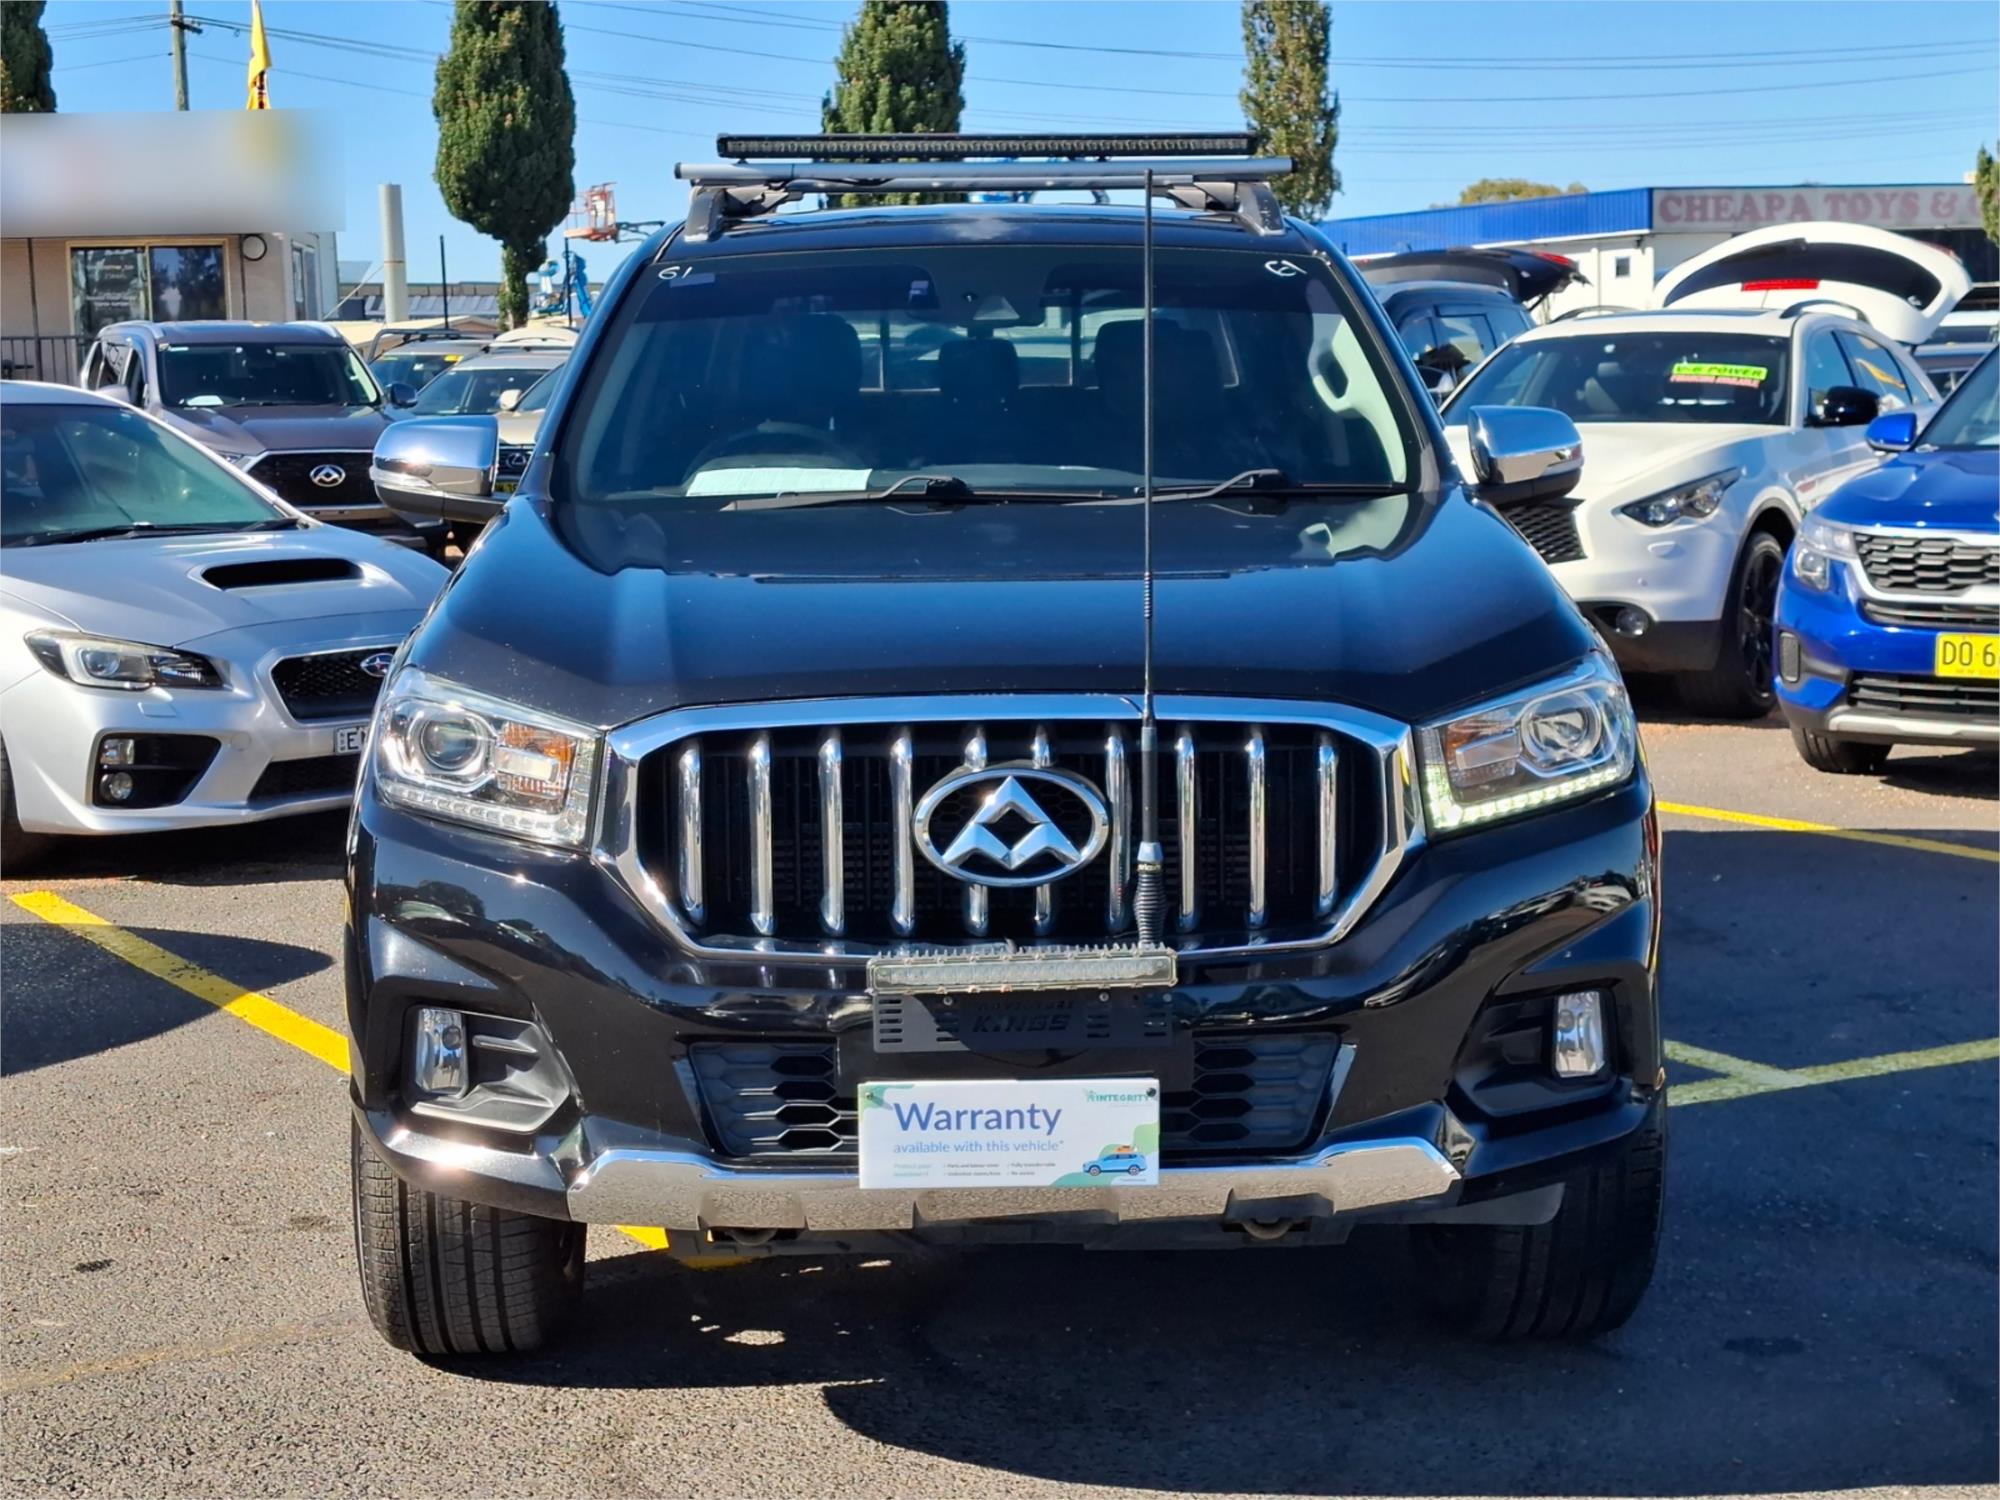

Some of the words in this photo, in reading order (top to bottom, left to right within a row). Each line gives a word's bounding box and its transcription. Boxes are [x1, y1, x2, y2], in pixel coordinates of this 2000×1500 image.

[1658, 193, 1813, 223] CHEAPA
[1824, 191, 1920, 219] TOYS
[1930, 192, 1955, 217] &
[658, 265, 693, 280] 61
[893, 1101, 1062, 1136] Warranty
[893, 1140, 950, 1154] available
[954, 1140, 982, 1153] with
[986, 1139, 1010, 1152] this
